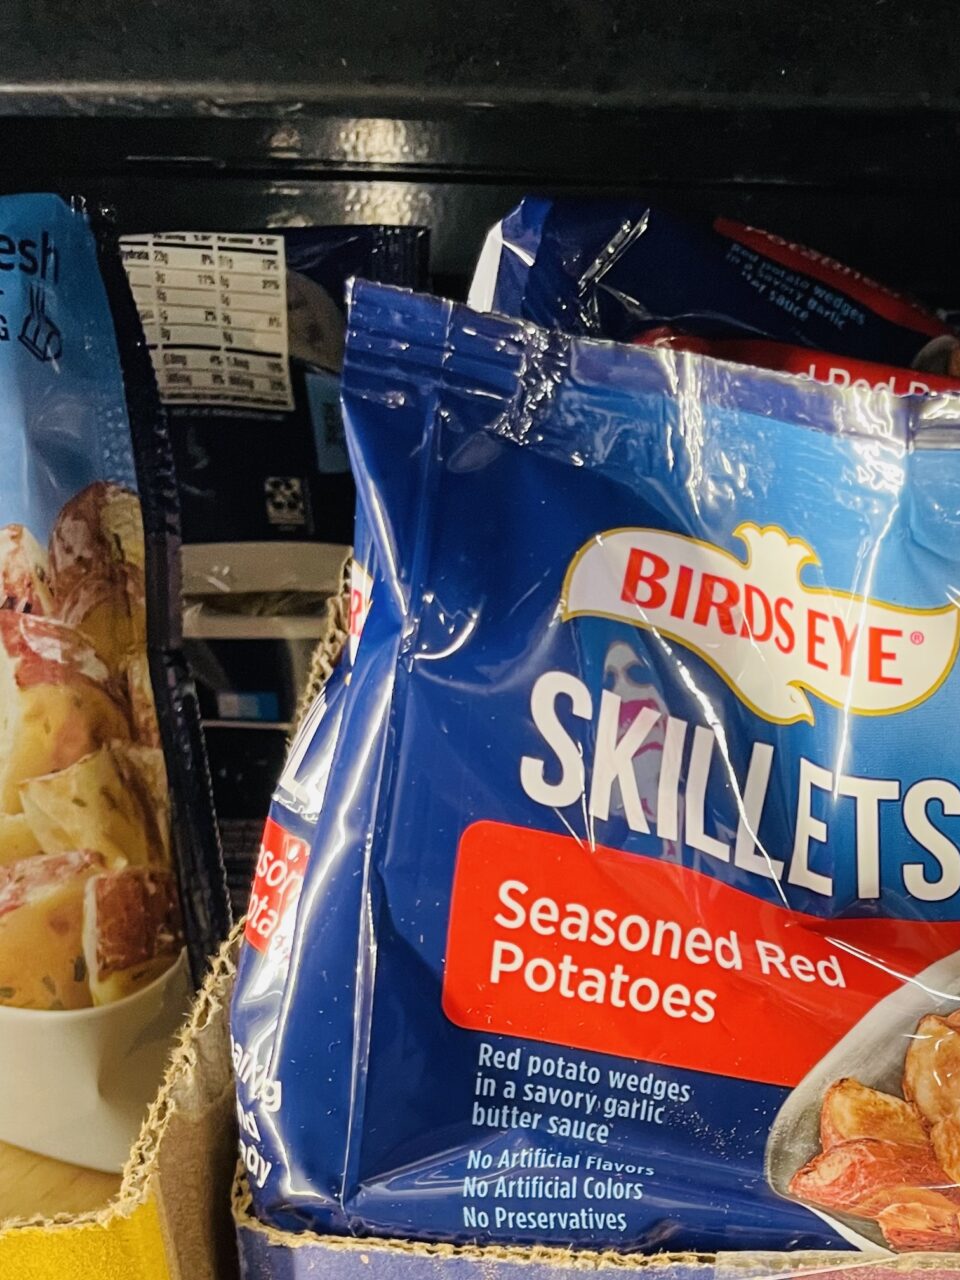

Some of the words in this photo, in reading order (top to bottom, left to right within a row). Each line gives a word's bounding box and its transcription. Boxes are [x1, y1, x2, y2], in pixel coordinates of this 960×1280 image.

[620, 547, 795, 656] BIRDS
[493, 878, 742, 973] Seasoned
[754, 938, 848, 990] Red
[488, 941, 719, 1026] Potatoes
[475, 1072, 497, 1097] in
[503, 1080, 517, 1100] a
[523, 1082, 598, 1115] savory
[603, 1094, 666, 1125] garlic
[478, 1042, 522, 1071] Red
[527, 1054, 601, 1085] potato
[608, 1070, 692, 1103] wedges
[471, 1102, 543, 1131] butter
[547, 1115, 610, 1144] sauce
[462, 1175, 489, 1199] No
[494, 1175, 578, 1199] Artificial
[583, 1176, 645, 1201] Colors
[466, 1149, 493, 1170] No
[497, 1148, 581, 1170] Artificial
[586, 1155, 656, 1177] Flavors
[462, 1206, 490, 1229] No
[494, 1206, 629, 1232] Preservatives
